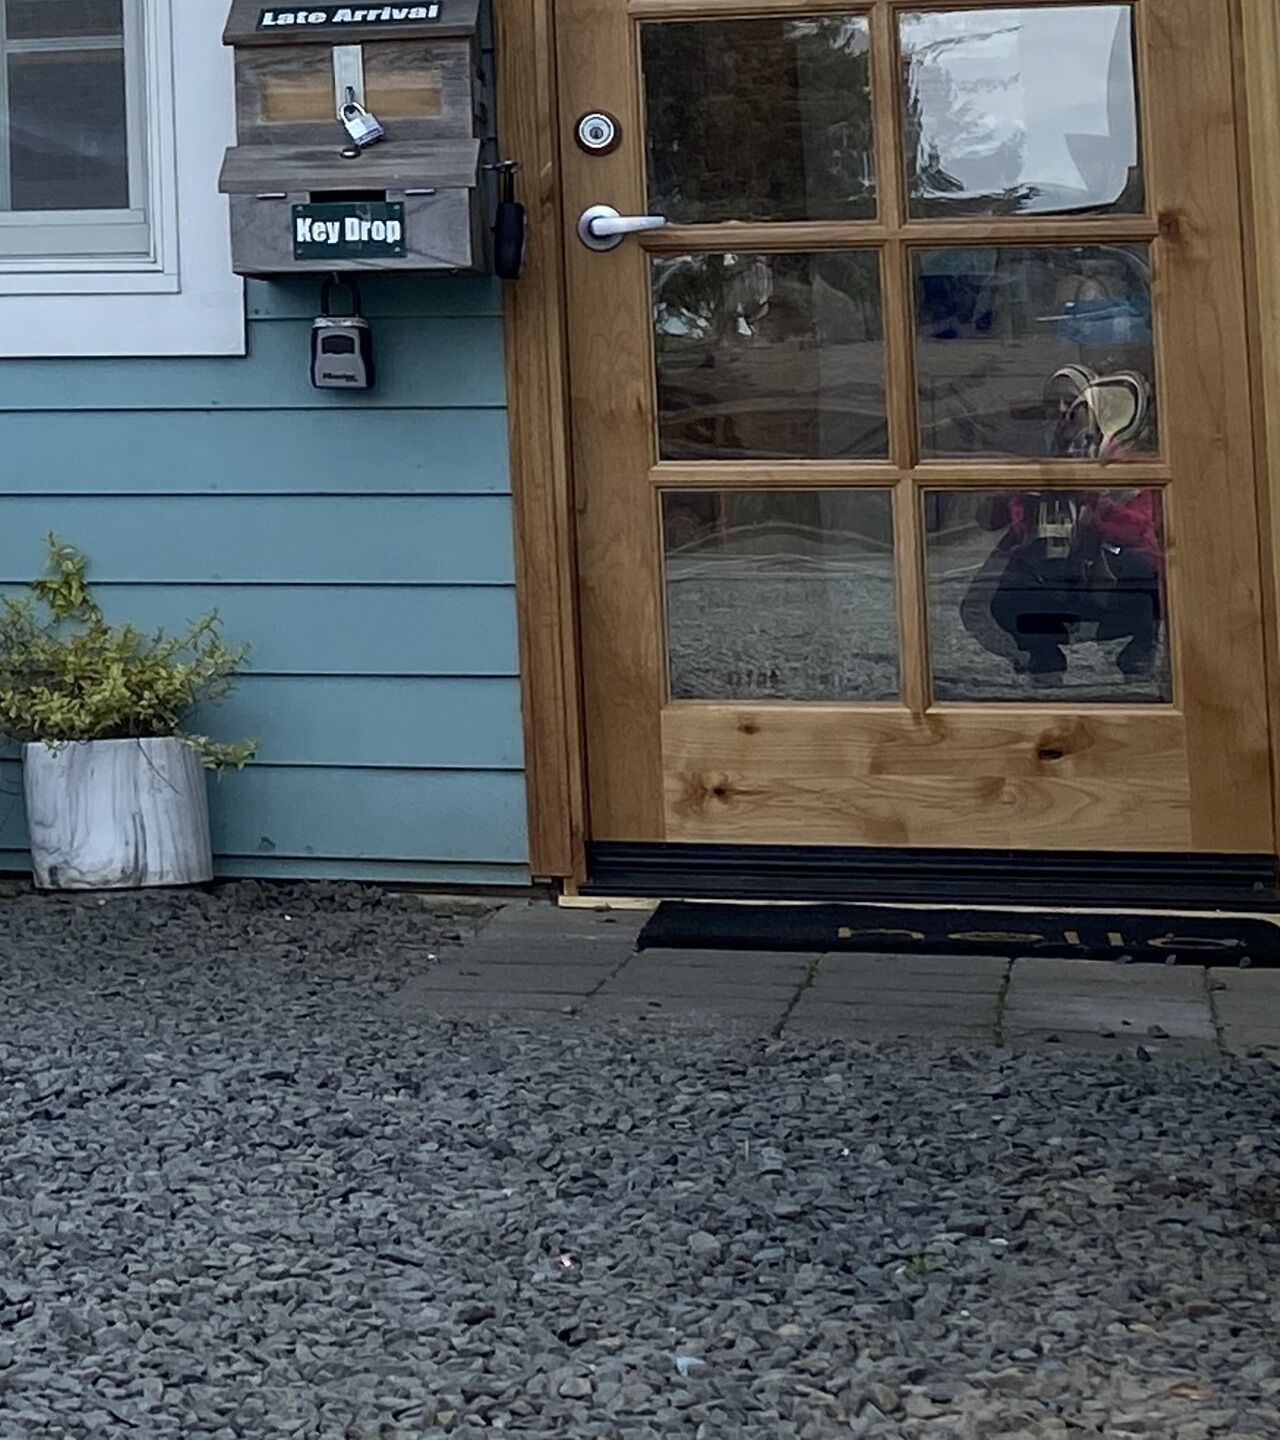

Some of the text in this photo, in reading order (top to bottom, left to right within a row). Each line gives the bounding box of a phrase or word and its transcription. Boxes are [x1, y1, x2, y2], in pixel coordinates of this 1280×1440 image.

[261, 3, 439, 27] Late Arrival
[296, 217, 402, 244] Key Drop
